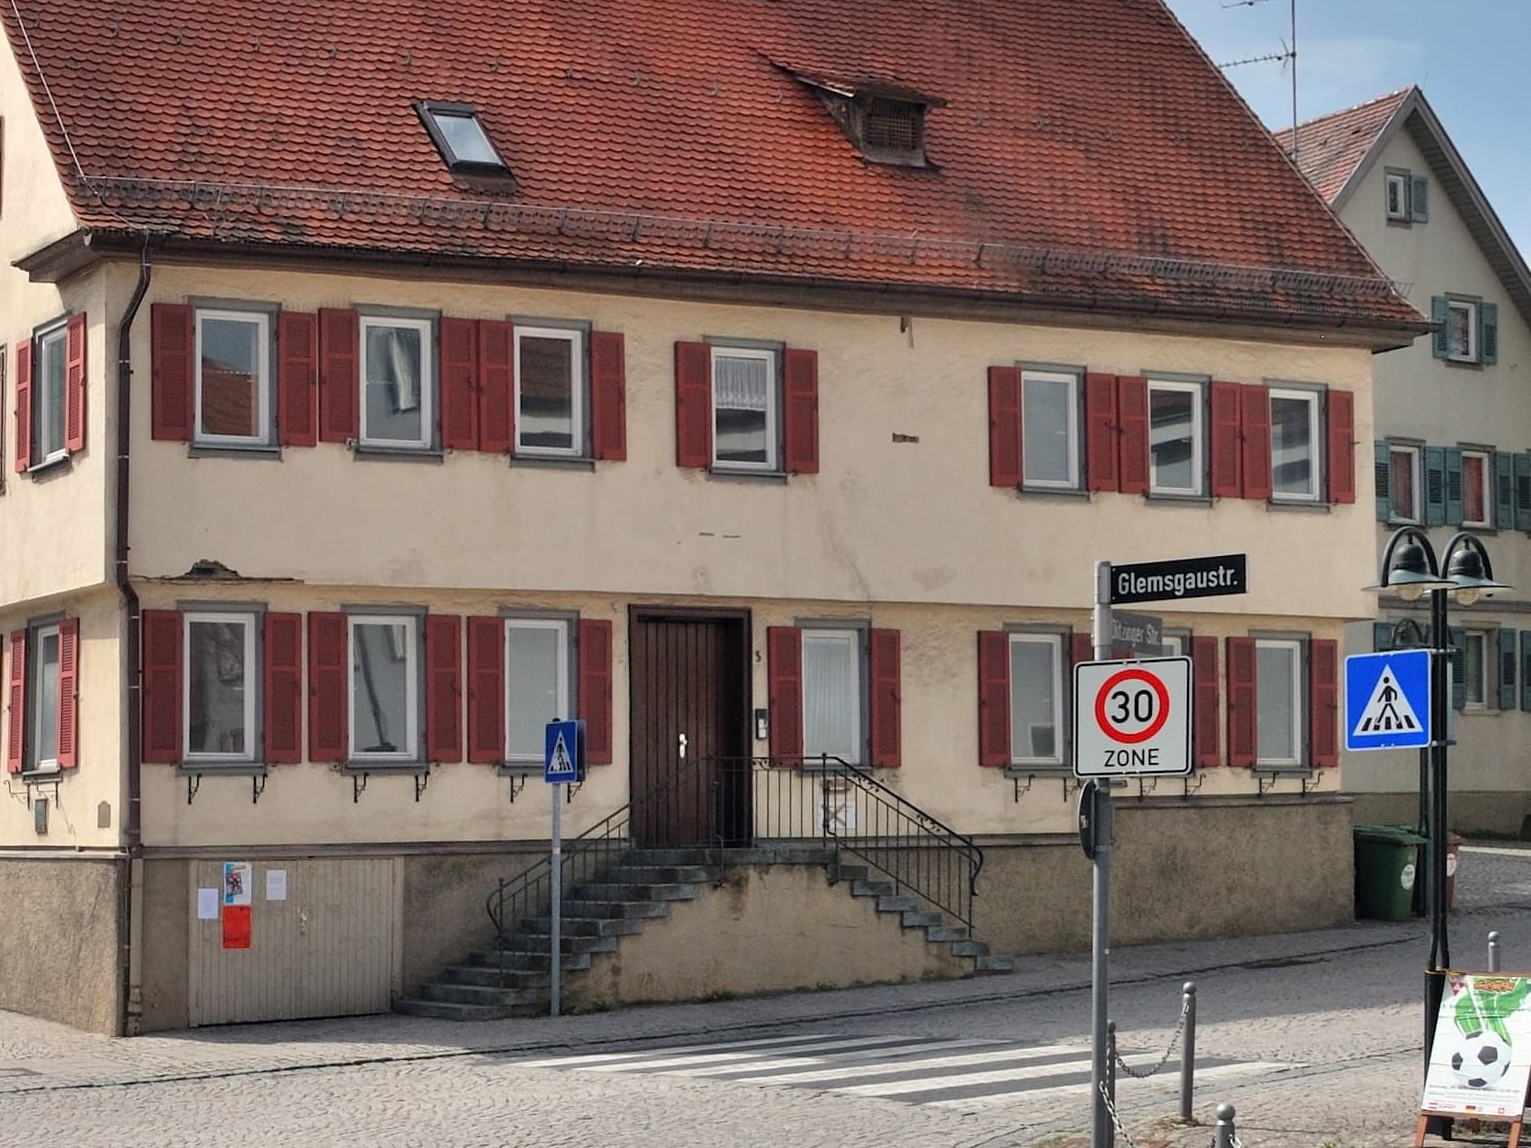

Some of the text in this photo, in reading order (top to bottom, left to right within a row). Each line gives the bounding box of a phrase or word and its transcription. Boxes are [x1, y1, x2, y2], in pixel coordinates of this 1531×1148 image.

[1117, 565, 1238, 596] Glemsgaustr.
[1110, 689, 1153, 724] 30
[1103, 748, 1160, 767] ZONE
